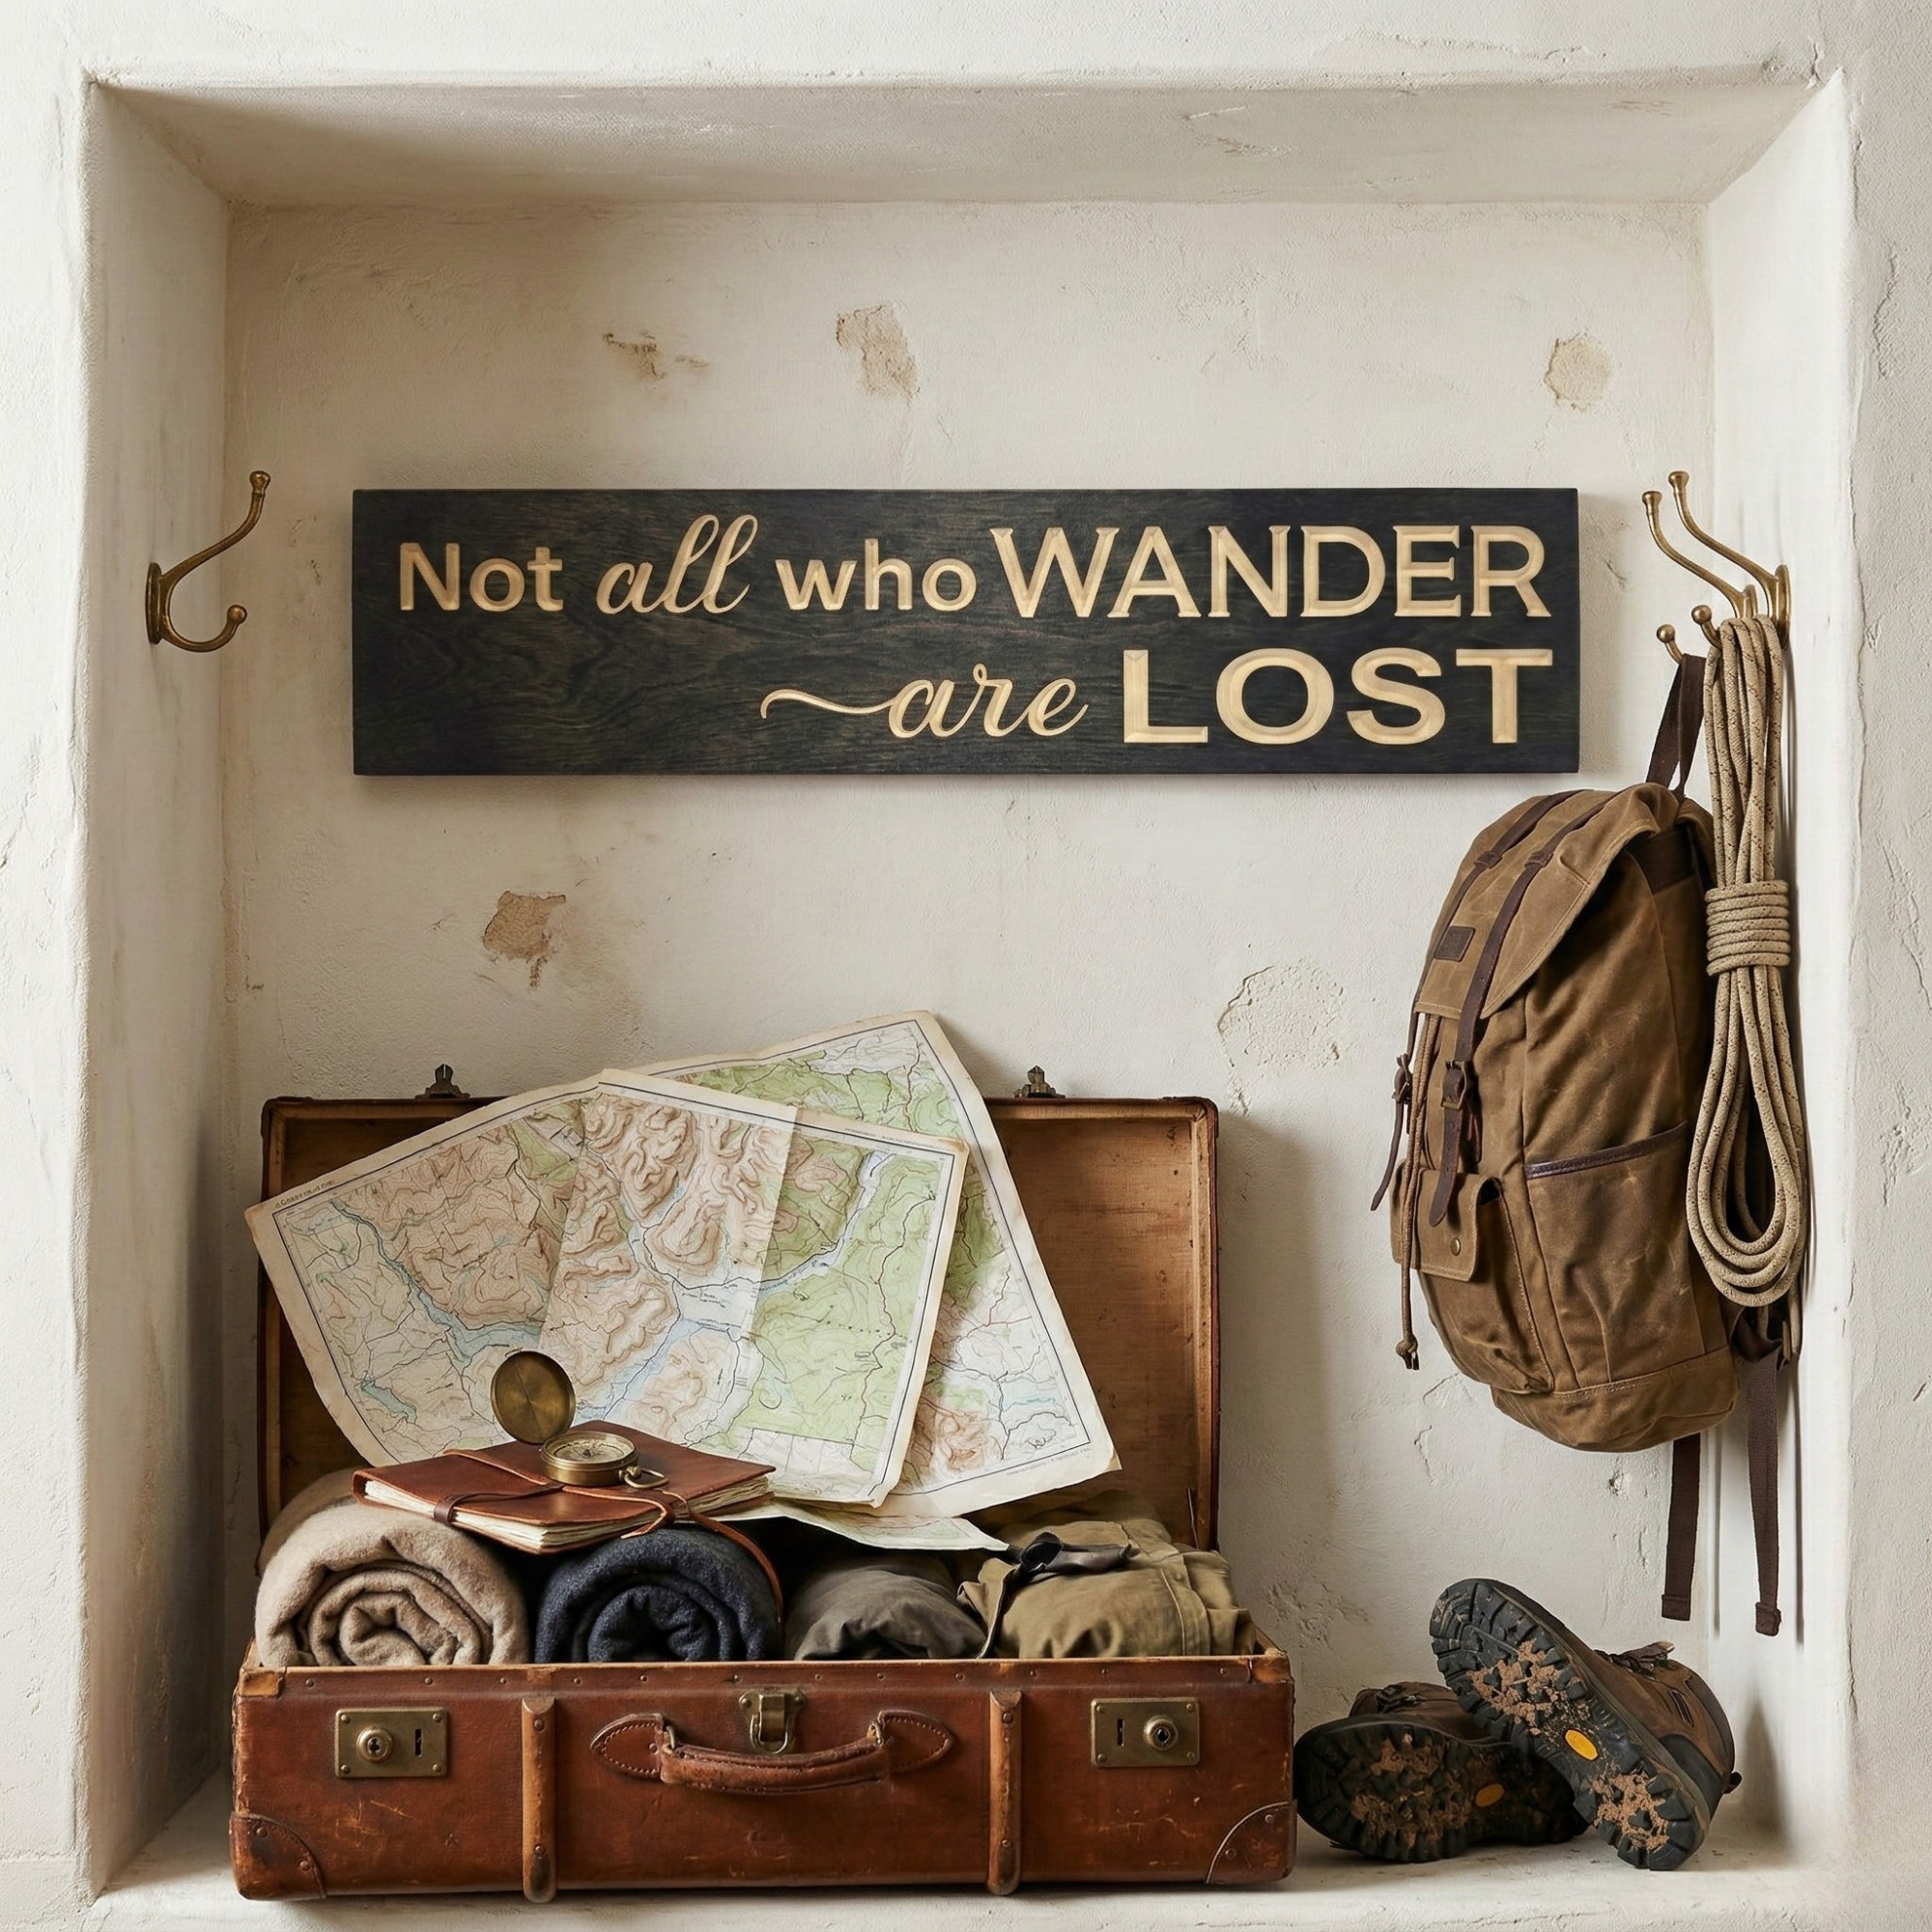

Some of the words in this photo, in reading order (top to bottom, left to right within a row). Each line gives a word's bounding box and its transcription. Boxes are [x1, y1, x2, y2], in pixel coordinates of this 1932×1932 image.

[399, 543, 563, 611] Not
[596, 514, 758, 614] all
[775, 538, 978, 612] who
[988, 525, 1551, 618] WANDER
[760, 664, 1090, 739] are
[1122, 647, 1553, 745] LOST
